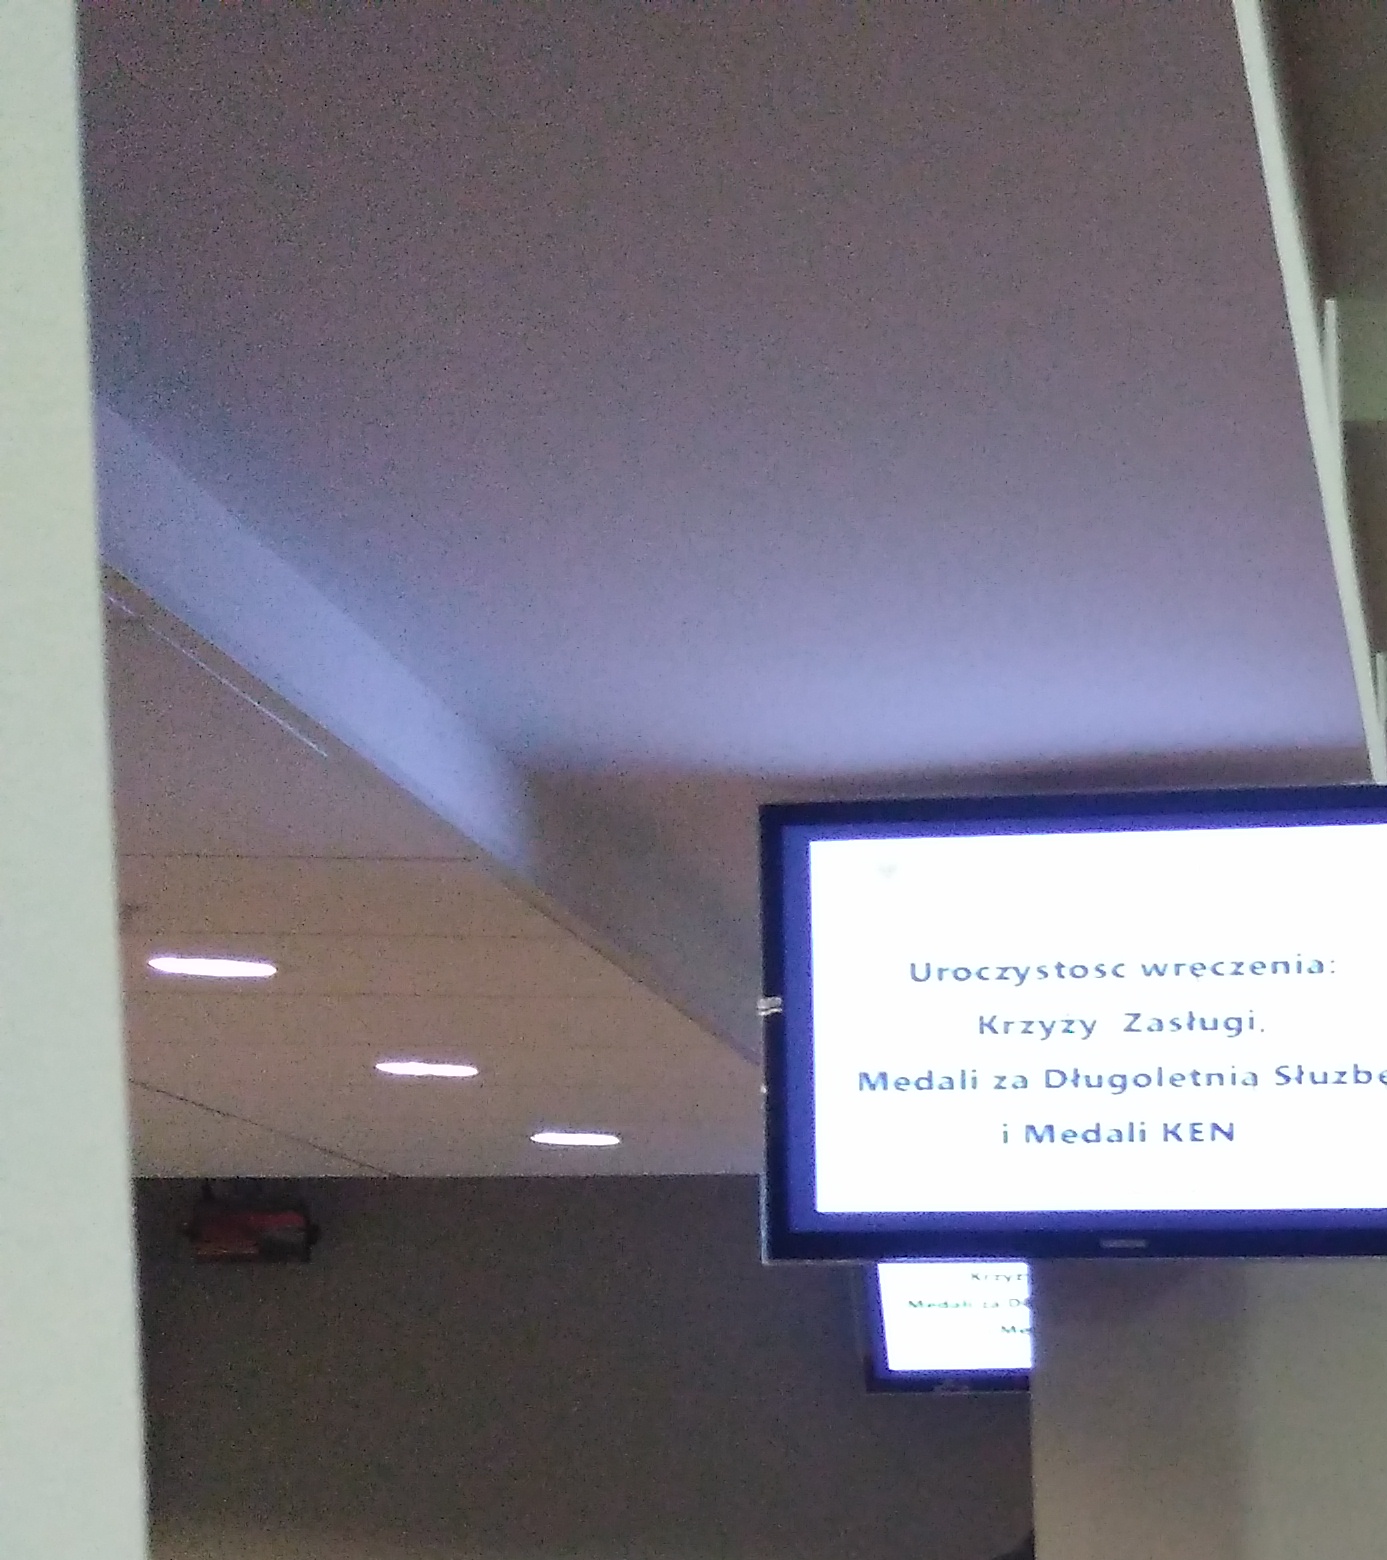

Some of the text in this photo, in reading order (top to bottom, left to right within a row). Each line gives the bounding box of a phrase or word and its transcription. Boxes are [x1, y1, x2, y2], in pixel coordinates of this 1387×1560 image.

[857, 1068, 979, 1092] Medali
[993, 1074, 1029, 1091] za
[1001, 1121, 1236, 1145] i Medali KEN
